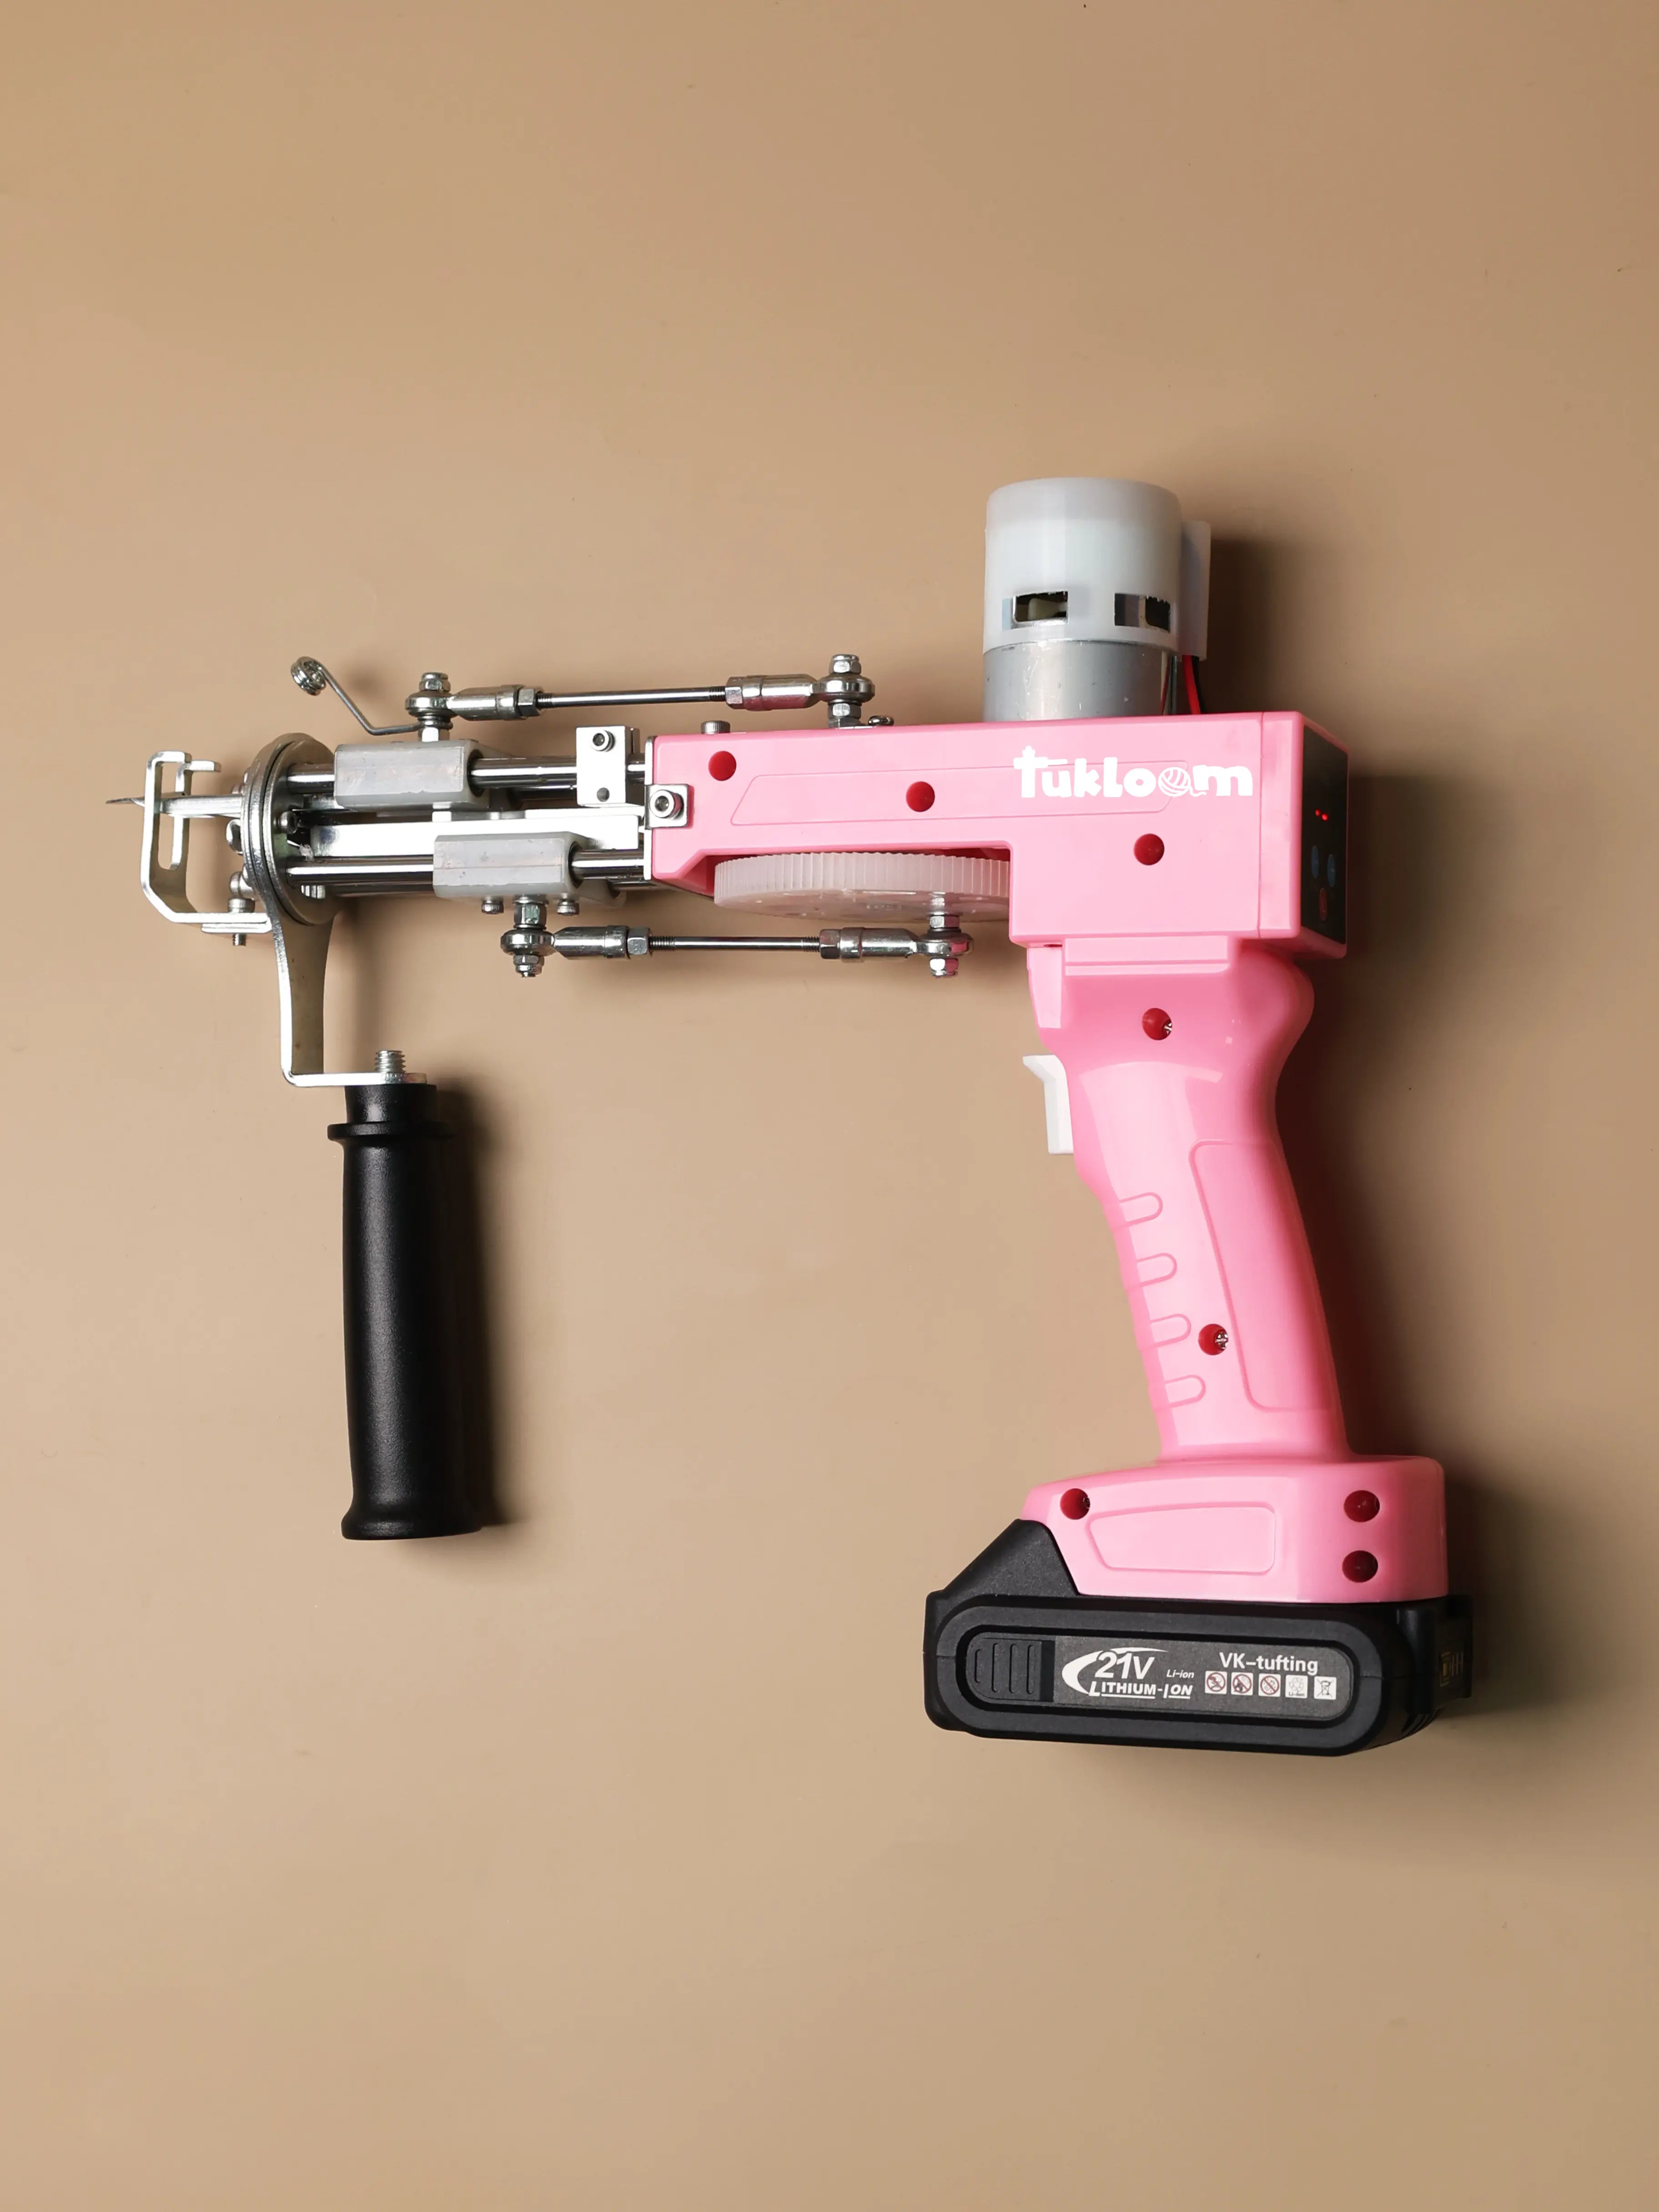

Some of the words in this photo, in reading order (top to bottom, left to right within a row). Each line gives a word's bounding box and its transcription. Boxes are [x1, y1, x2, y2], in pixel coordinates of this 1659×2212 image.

[1095, 1652, 1155, 1679] 21V
[1166, 1669, 1195, 1679] Li-ion
[1219, 1652, 1318, 1676] VK-tufting
